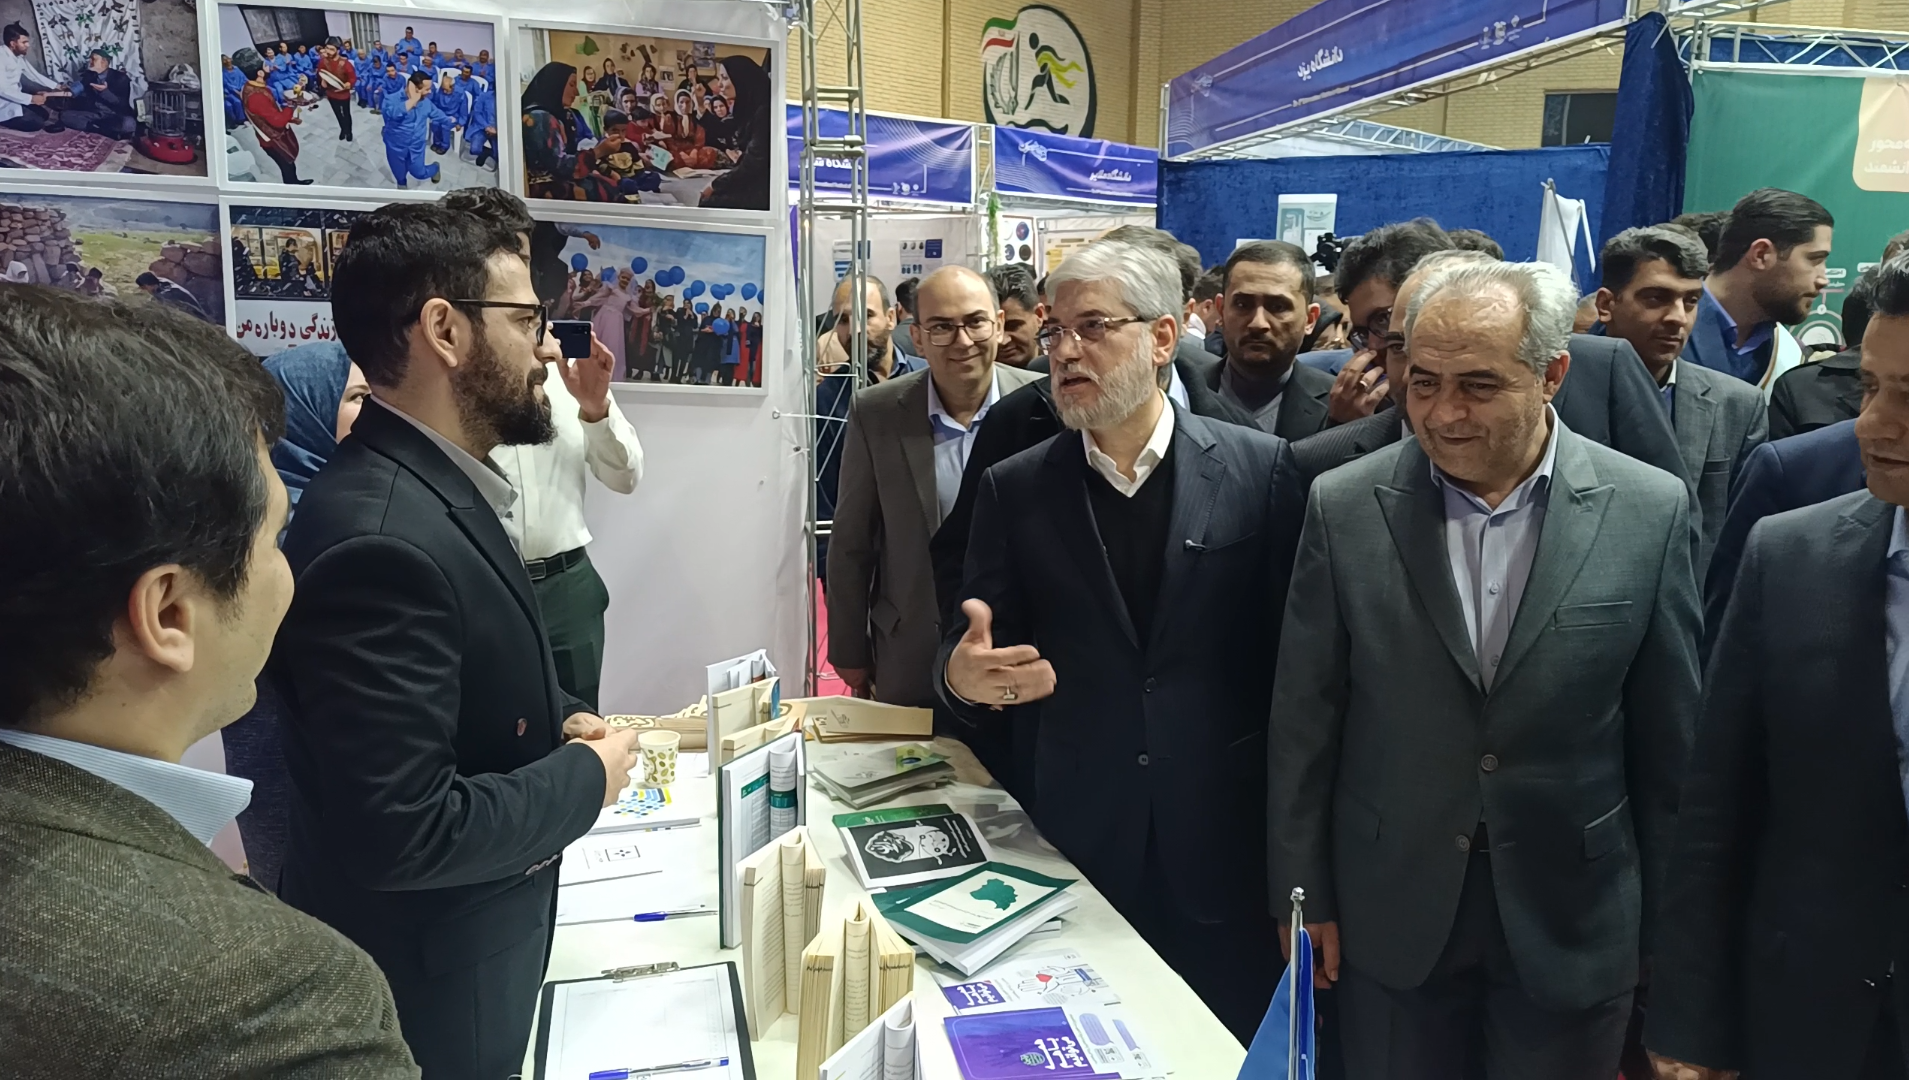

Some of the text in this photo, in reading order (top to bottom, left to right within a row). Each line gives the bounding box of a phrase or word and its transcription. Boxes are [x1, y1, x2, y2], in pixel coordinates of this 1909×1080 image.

[1297, 46, 1344, 81] دانشگاه یزد
[236, 311, 337, 341] زندگی دوباره من
